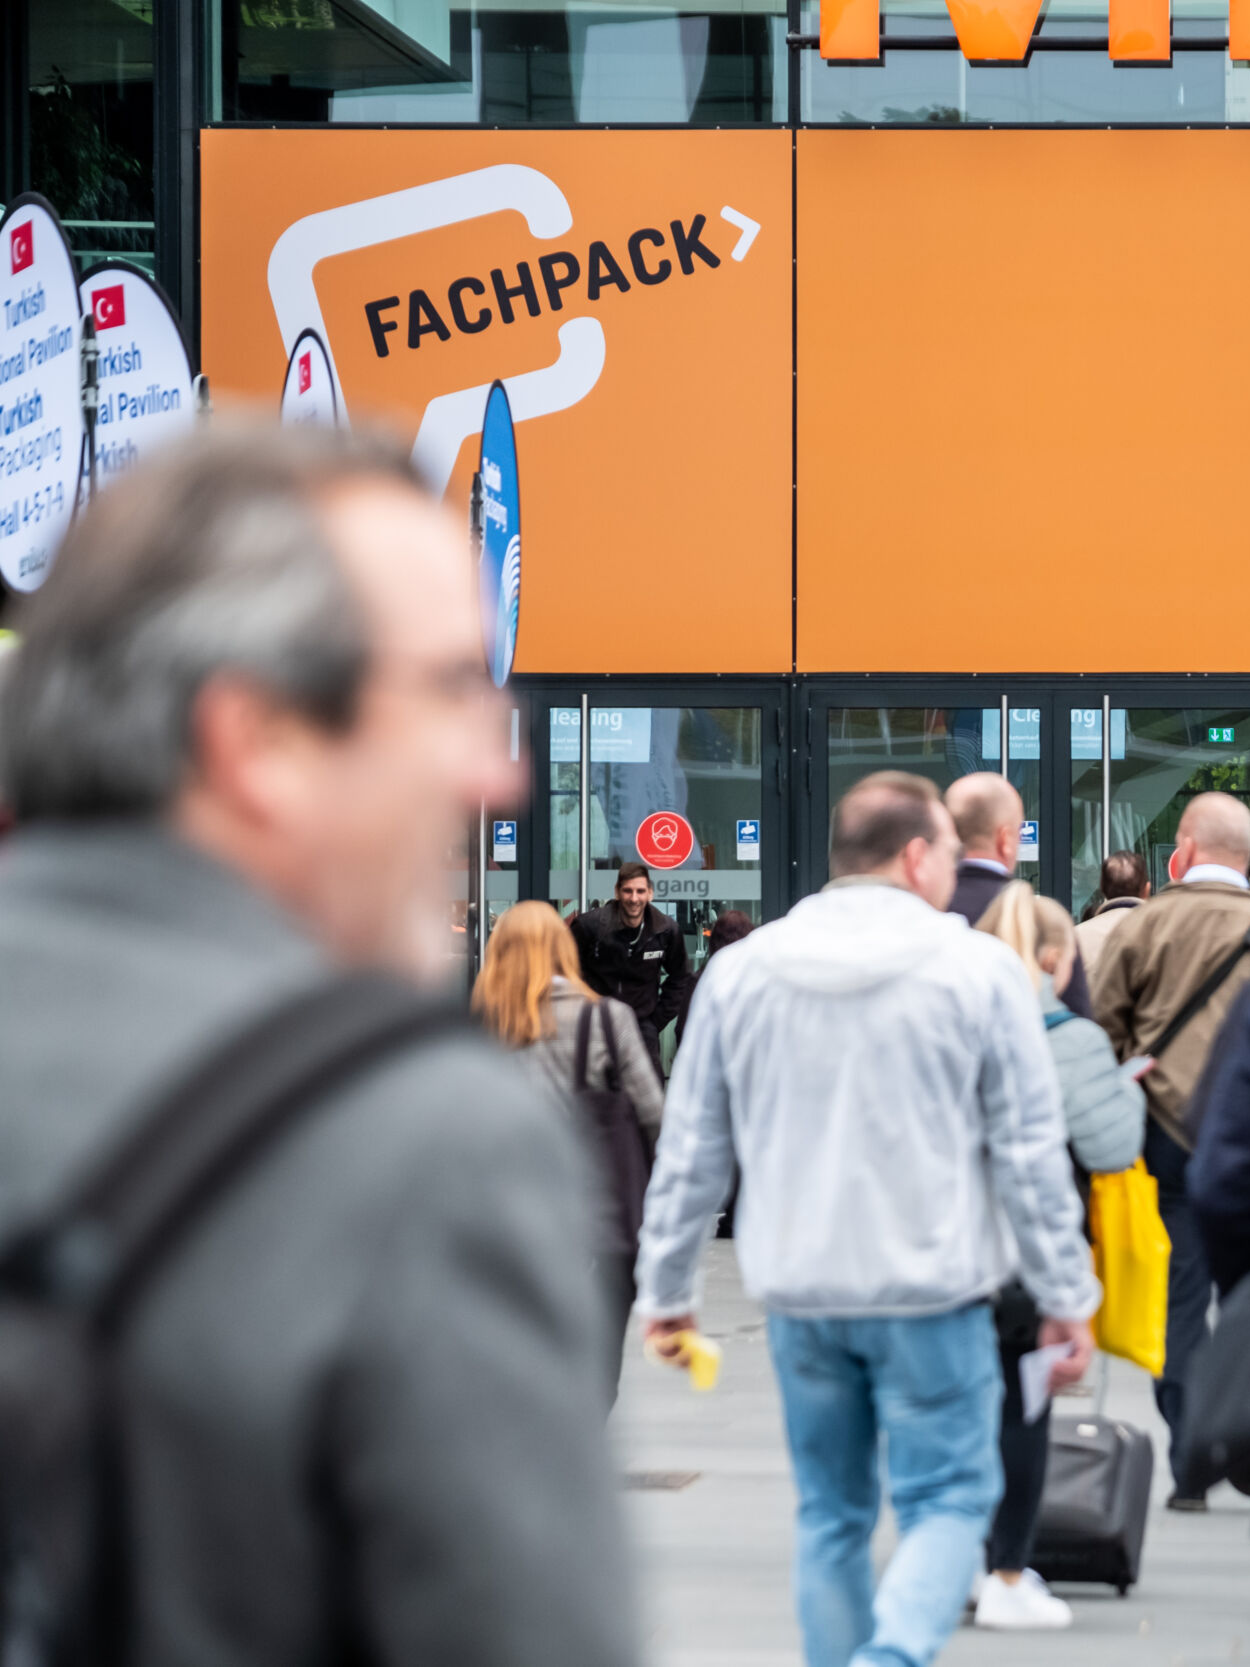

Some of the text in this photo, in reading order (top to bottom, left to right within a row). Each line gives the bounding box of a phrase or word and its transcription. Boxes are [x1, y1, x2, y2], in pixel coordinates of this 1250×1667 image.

[5, 281, 46, 329] Turkish
[364, 214, 721, 358] FACHPACK
[28, 325, 73, 370] Pavilion
[118, 383, 180, 421] Pavilion
